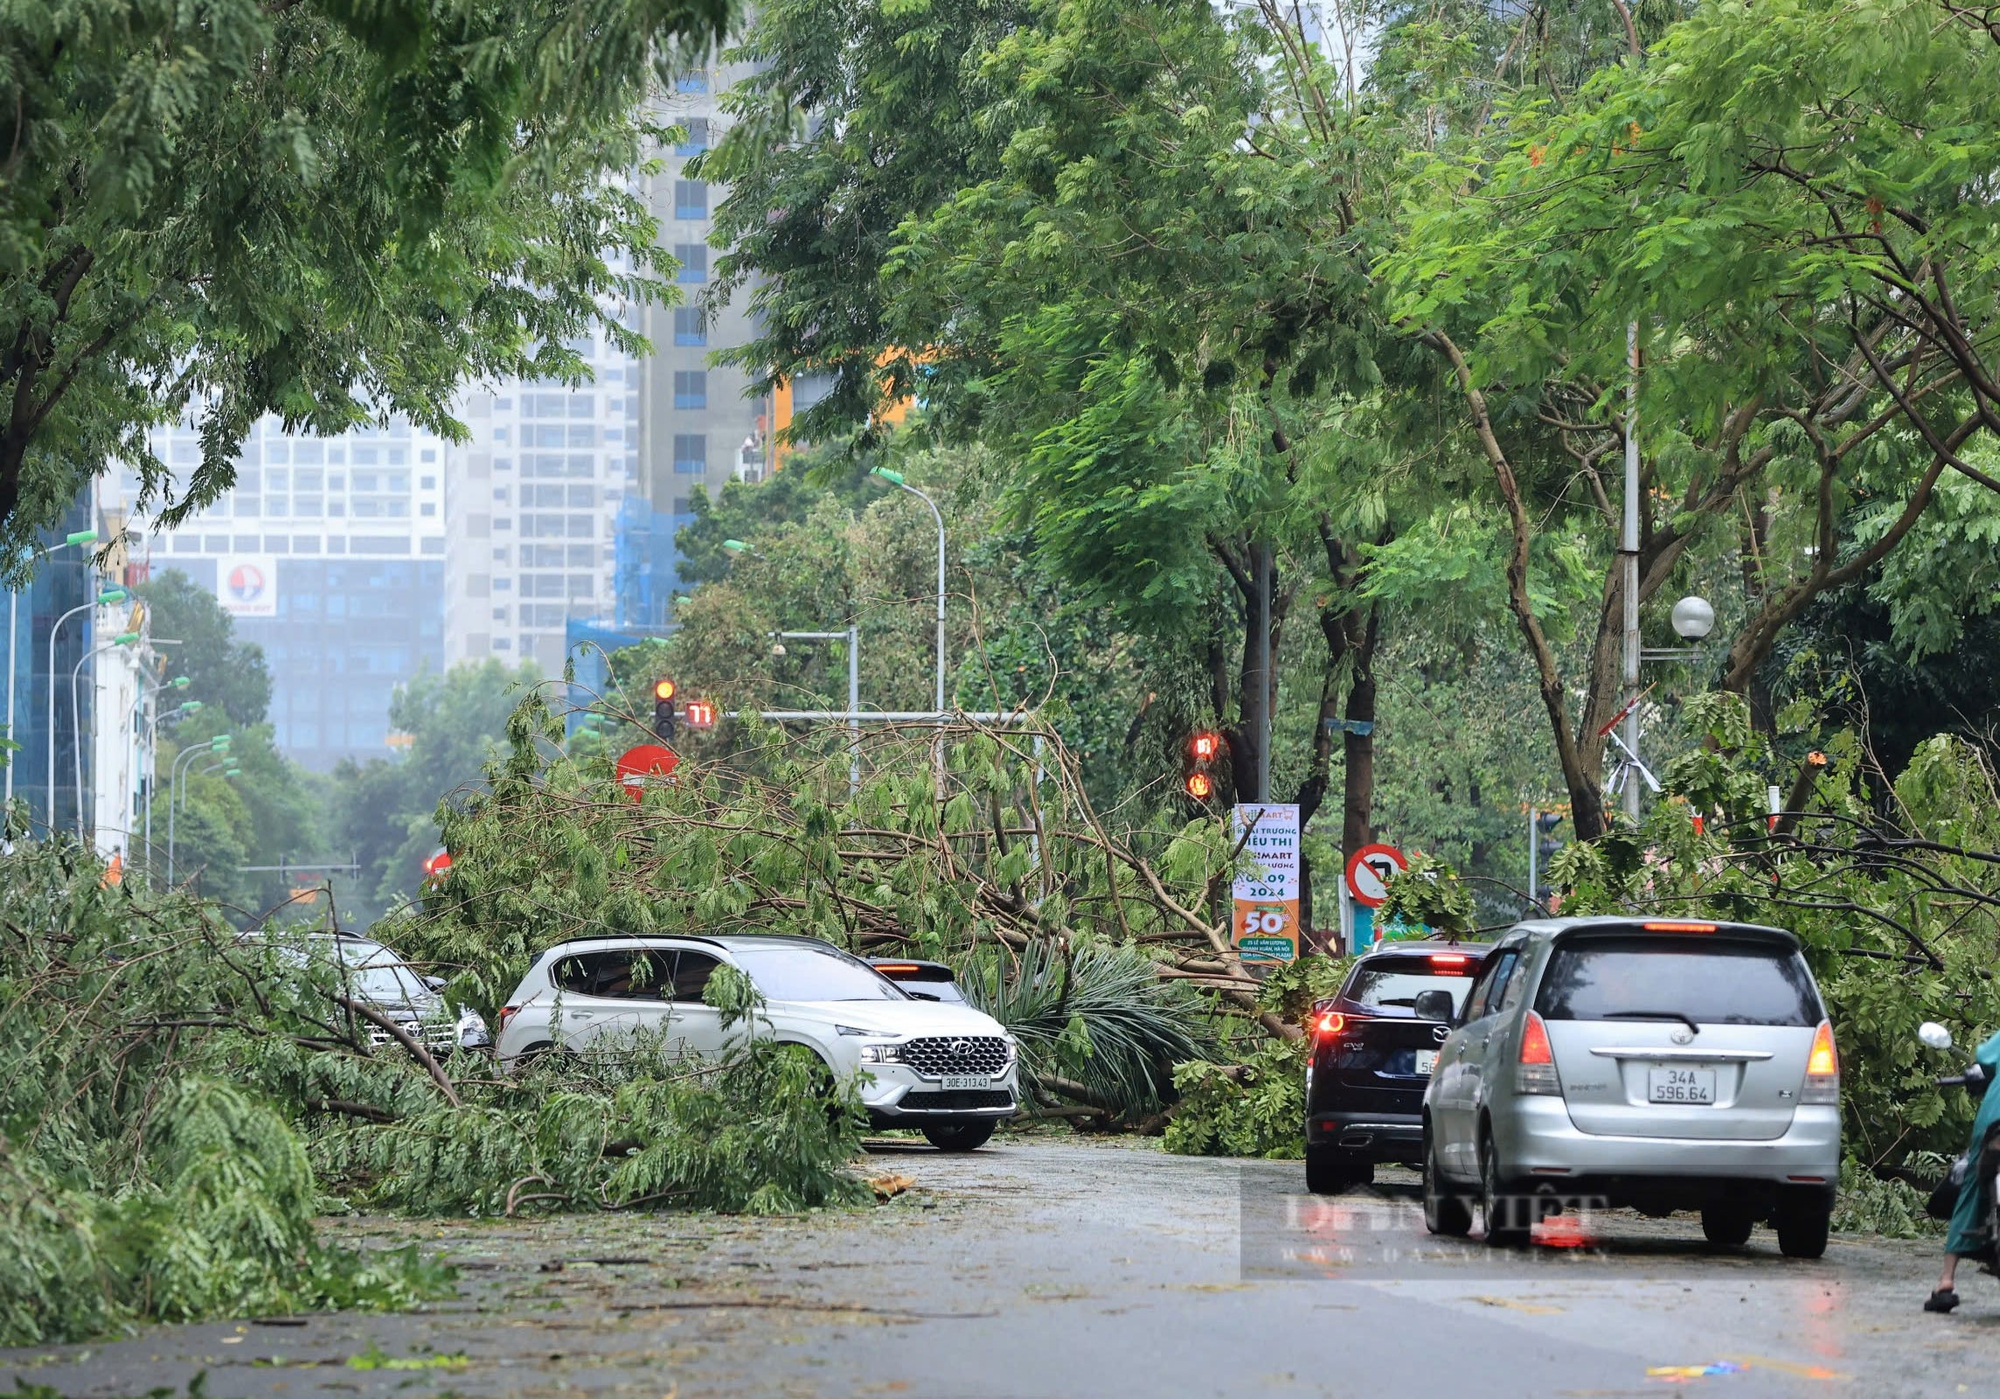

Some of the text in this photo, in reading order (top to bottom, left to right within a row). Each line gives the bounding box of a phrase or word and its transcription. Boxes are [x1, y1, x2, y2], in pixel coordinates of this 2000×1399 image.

[1247, 835, 1292, 848] IÊU THỊ
[1250, 887, 1285, 897] 2024
[946, 1078, 988, 1088] 30E-313.43
[1669, 1070, 1696, 1085] 34A
[1657, 1086, 1707, 1101] 596.64
